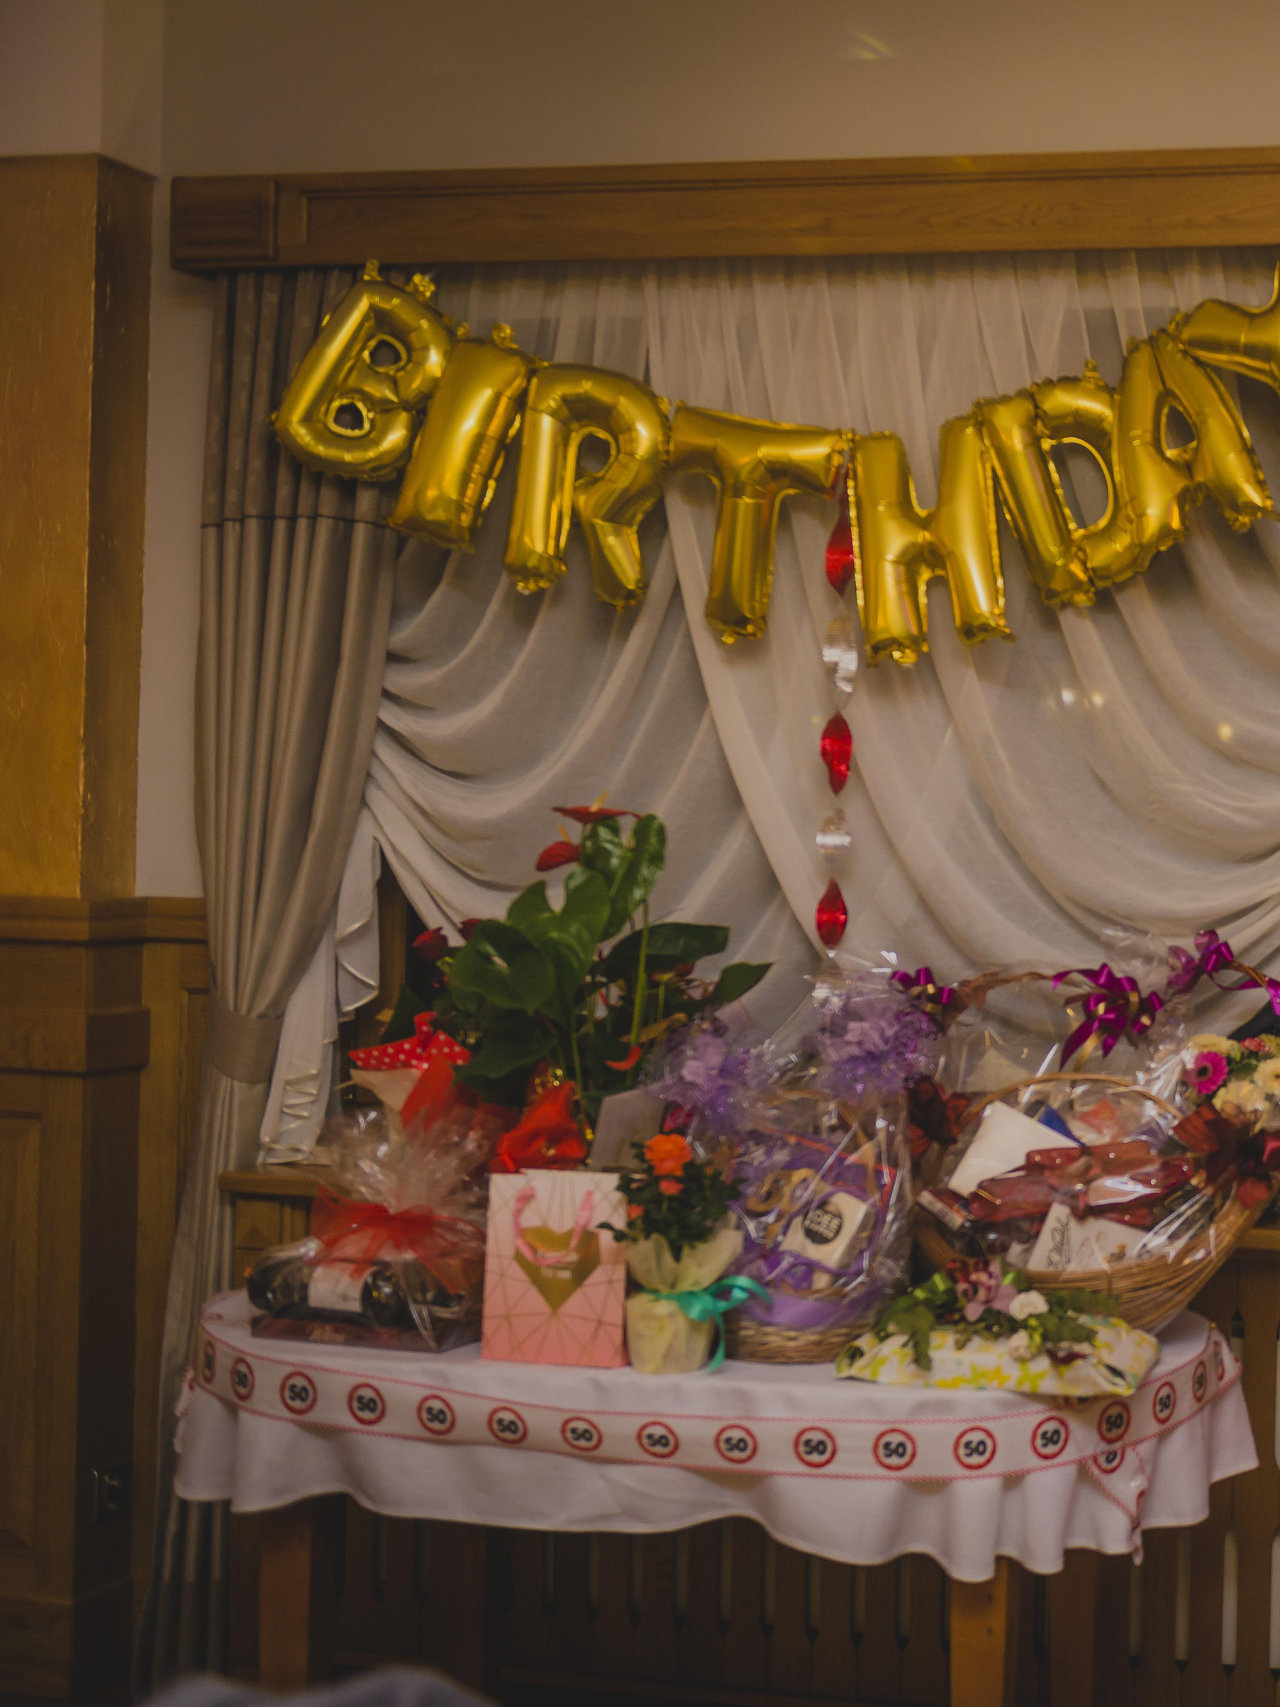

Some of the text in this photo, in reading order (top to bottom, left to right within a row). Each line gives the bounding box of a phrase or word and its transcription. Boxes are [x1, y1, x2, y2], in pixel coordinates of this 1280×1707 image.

[287, 1383, 310, 1403] 50
[356, 1395, 379, 1414] 50
[1158, 1394, 1171, 1413] 50
[425, 1406, 447, 1425] 50
[1104, 1412, 1124, 1432] 50
[495, 1418, 519, 1435] 50
[569, 1427, 593, 1443] 50
[646, 1433, 670, 1449] 50
[723, 1437, 748, 1453] 50
[802, 1438, 827, 1455] 50
[1040, 1429, 1061, 1447] 50
[882, 1441, 907, 1458] 50
[963, 1440, 987, 1457] 50
